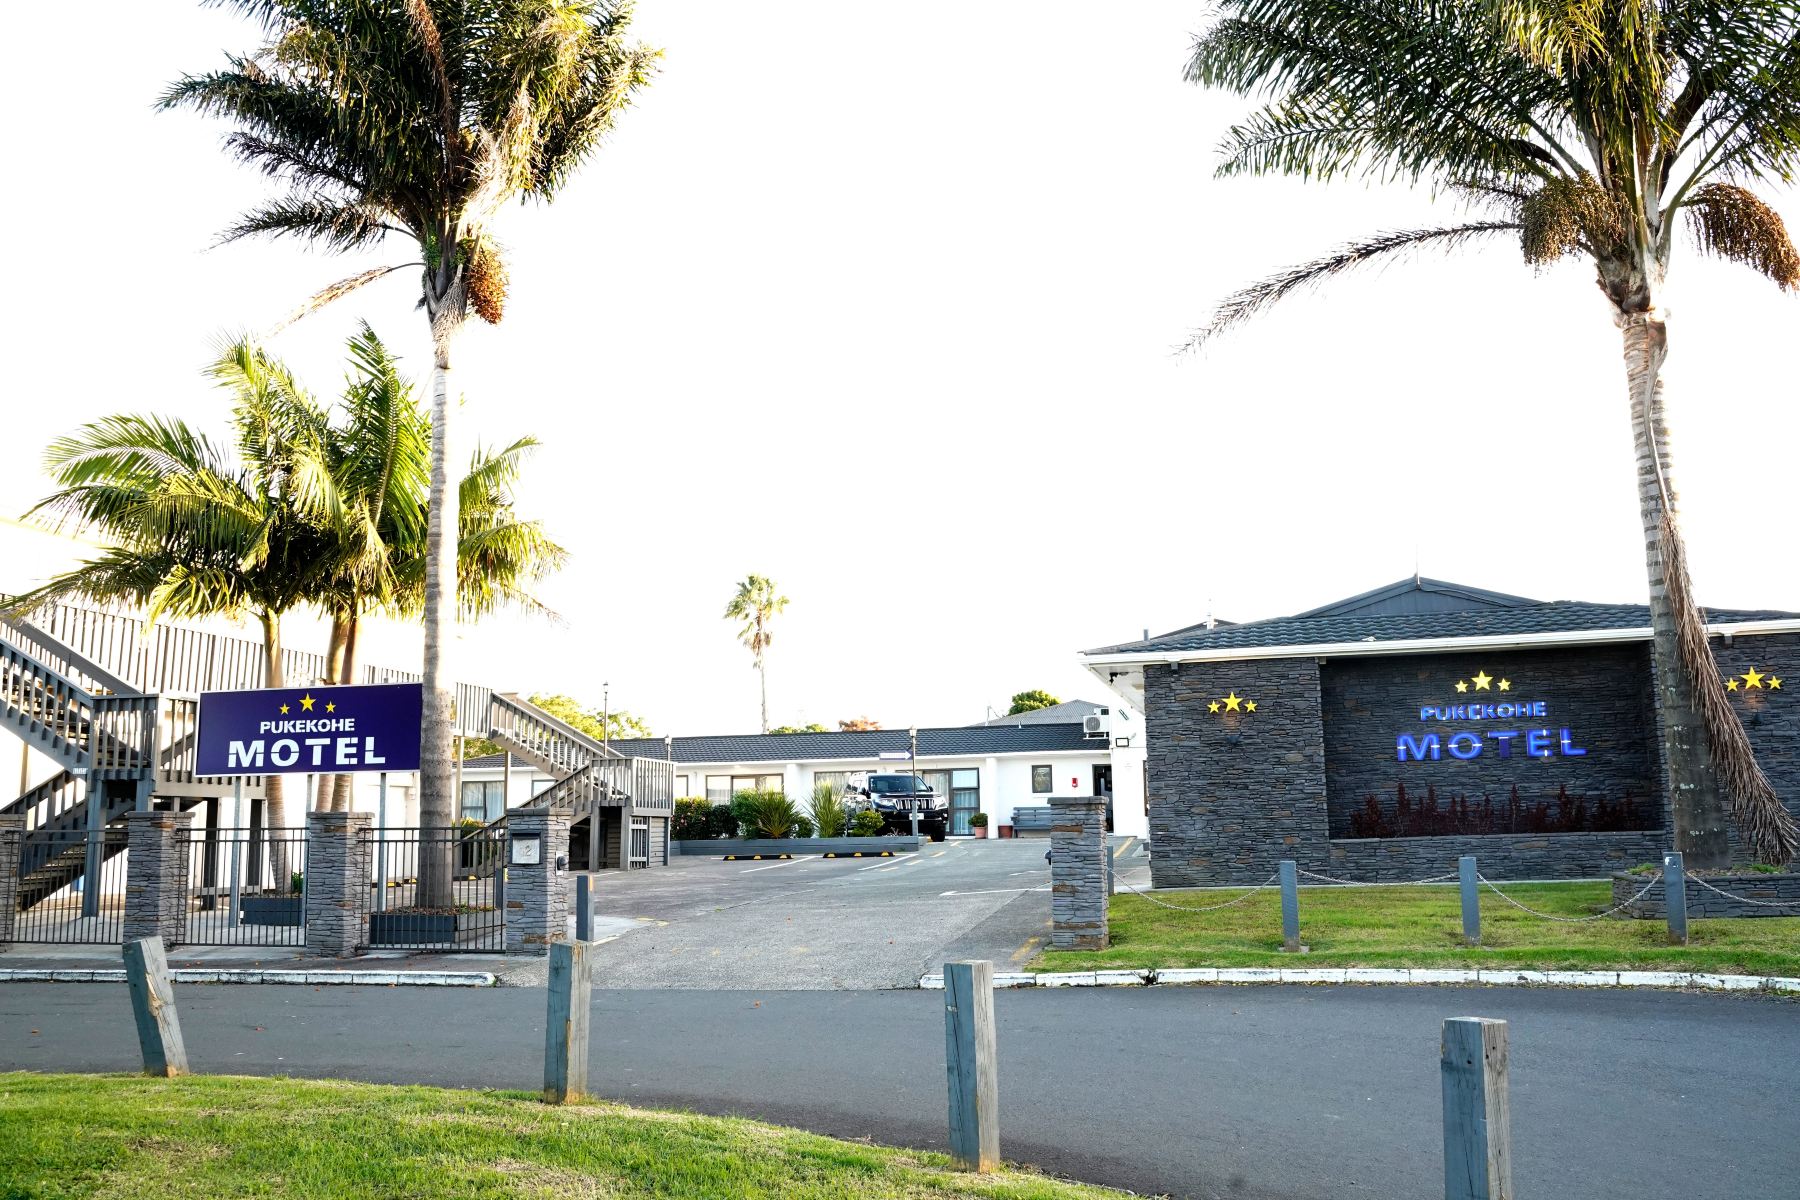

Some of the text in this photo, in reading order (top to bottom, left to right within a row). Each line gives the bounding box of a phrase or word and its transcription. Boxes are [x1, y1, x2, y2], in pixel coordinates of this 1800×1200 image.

[1420, 701, 1547, 721] PUKEKOHE
[260, 718, 355, 734] PUKEKOHE
[227, 736, 386, 768] MOTEL
[1396, 727, 1587, 762] MOTEL
